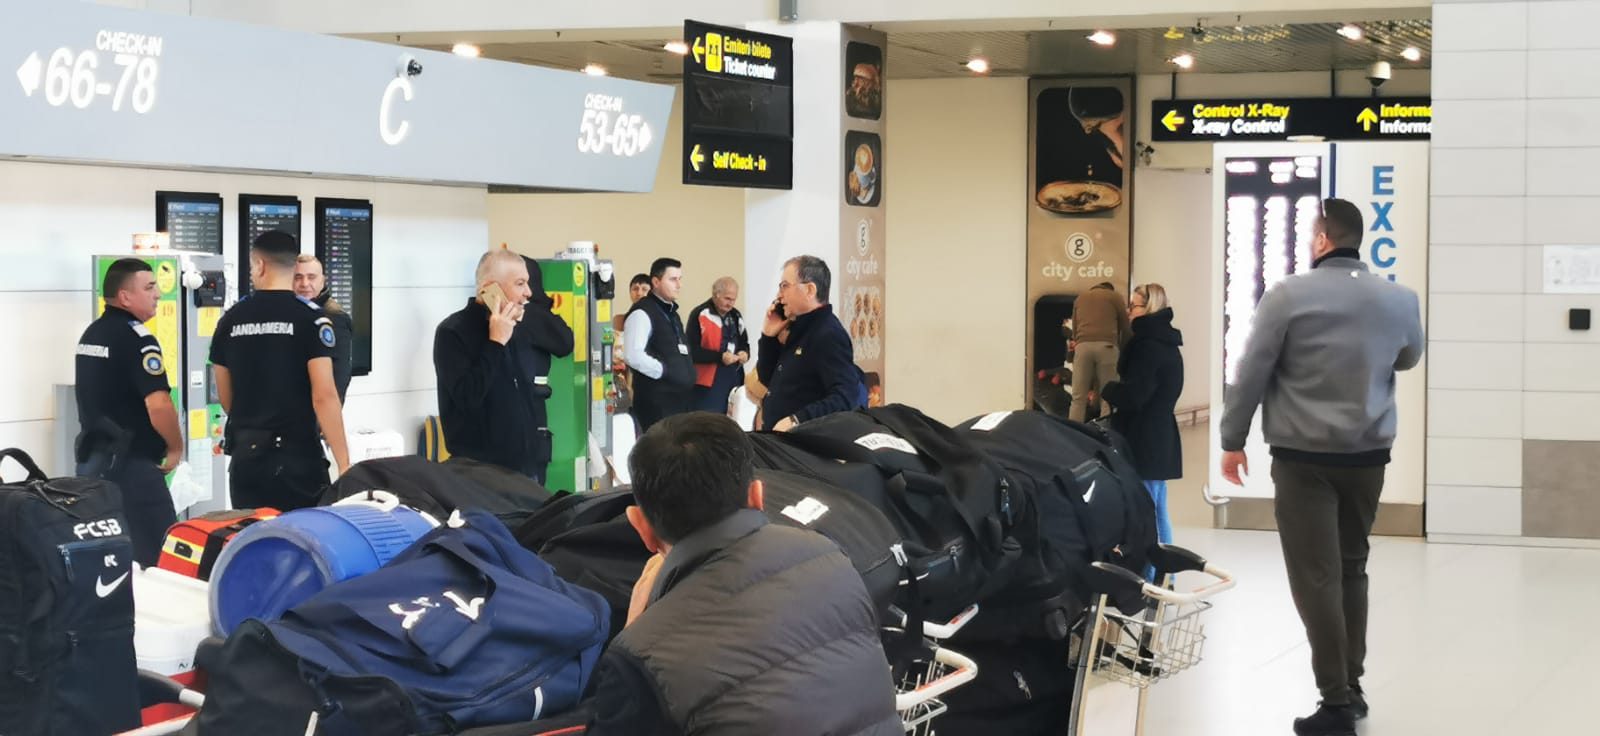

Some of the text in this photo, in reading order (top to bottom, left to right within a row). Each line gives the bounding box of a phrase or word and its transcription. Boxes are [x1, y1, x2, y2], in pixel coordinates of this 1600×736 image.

[96, 29, 162, 56] CHECK-IN
[752, 41, 771, 59] bilete
[724, 56, 776, 79] Ticket counter
[46, 47, 158, 113] 66-78
[379, 77, 412, 145] C
[585, 93, 622, 112] CHECK-IN
[1192, 104, 1289, 119] Control X-Ray
[578, 109, 641, 156] 53-65
[1192, 119, 1284, 136] X-ray Control
[713, 151, 729, 168] Self
[730, 153, 753, 170] Check
[1370, 165, 1396, 282] EXC
[847, 255, 878, 280] city cafe
[1042, 261, 1114, 281] city cafe
[230, 322, 294, 337] JANDARMERIA
[73, 518, 122, 540] FCSB
